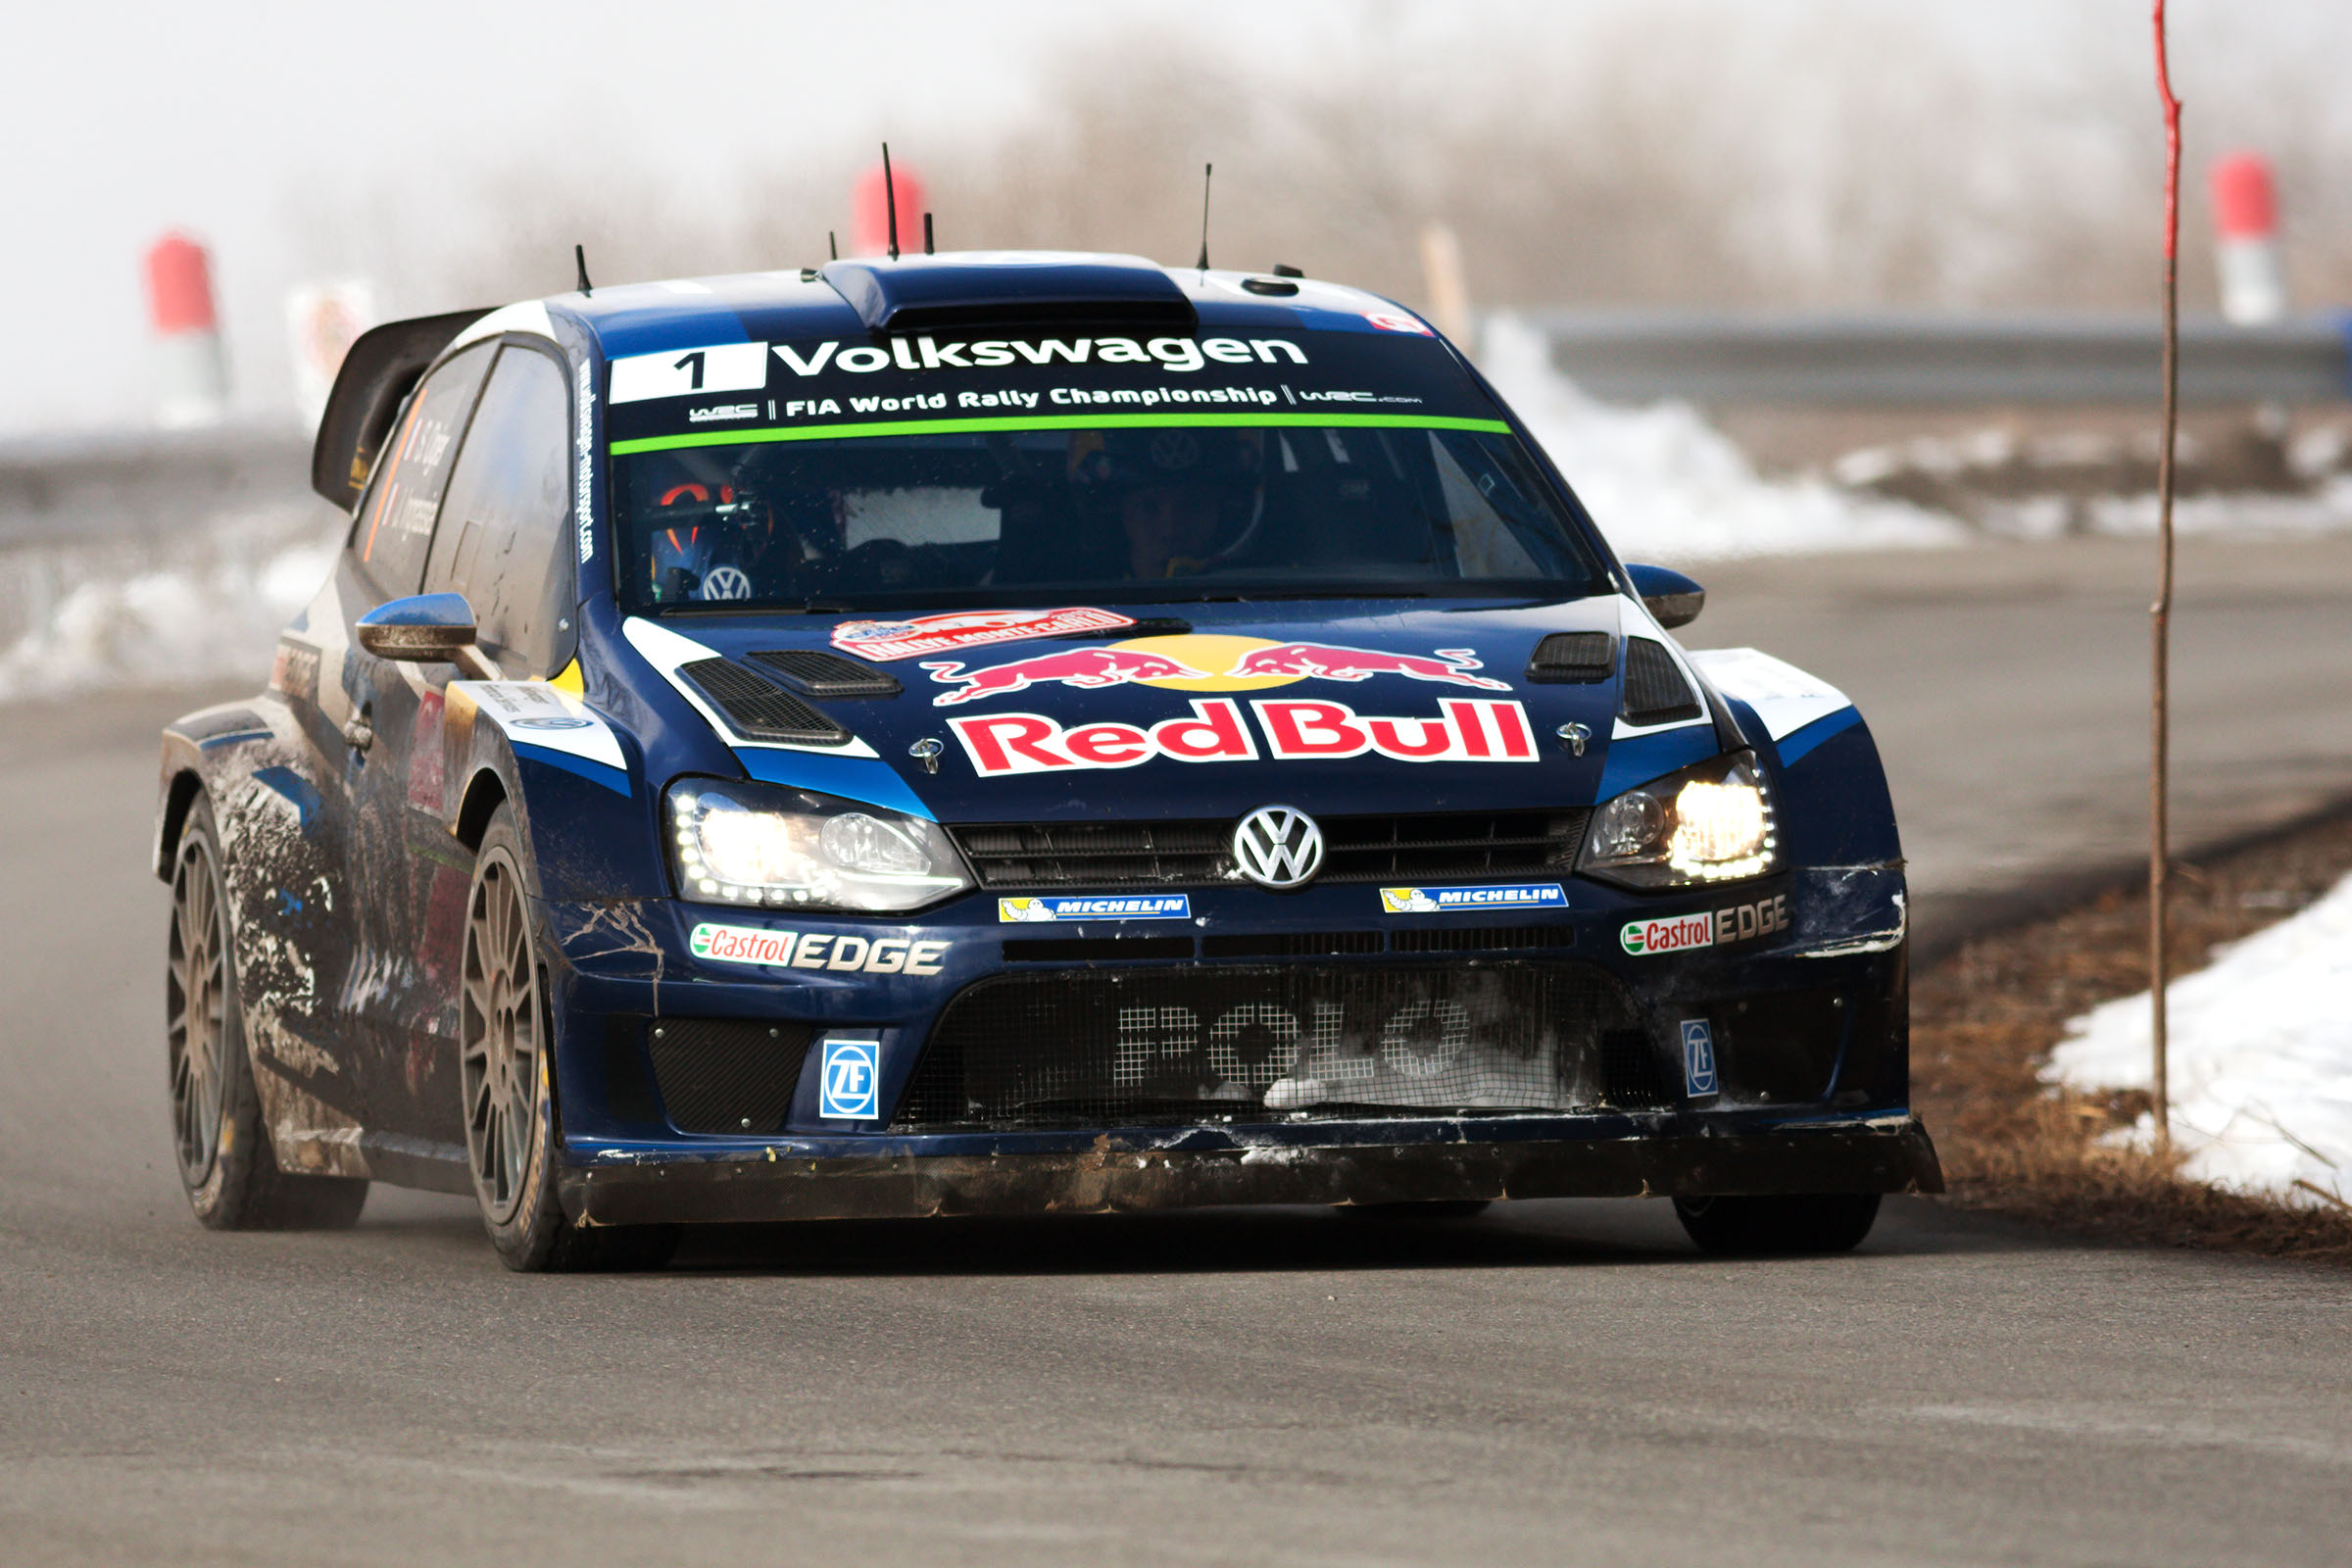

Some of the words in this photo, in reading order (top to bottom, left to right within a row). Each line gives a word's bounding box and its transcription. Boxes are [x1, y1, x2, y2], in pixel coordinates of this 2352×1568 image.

[672, 351, 706, 389] 1
[770, 335, 1309, 376] Volkswagen
[786, 397, 841, 416] FIA
[849, 393, 948, 414] World
[957, 388, 1040, 409] Rally
[1050, 386, 1278, 406] Championship
[858, 635, 950, 659] RALLYE
[1055, 899, 1184, 913] MICHELIN
[1438, 888, 1559, 904] MICHELIN
[1646, 915, 1711, 952] Castrol
[1715, 894, 1789, 946] EDGE
[710, 929, 789, 962] Castrol
[791, 933, 953, 976] EDGE
[1113, 999, 1470, 1087] POLO
[1688, 1038, 1713, 1078] ZF
[828, 1058, 872, 1100] ZF
